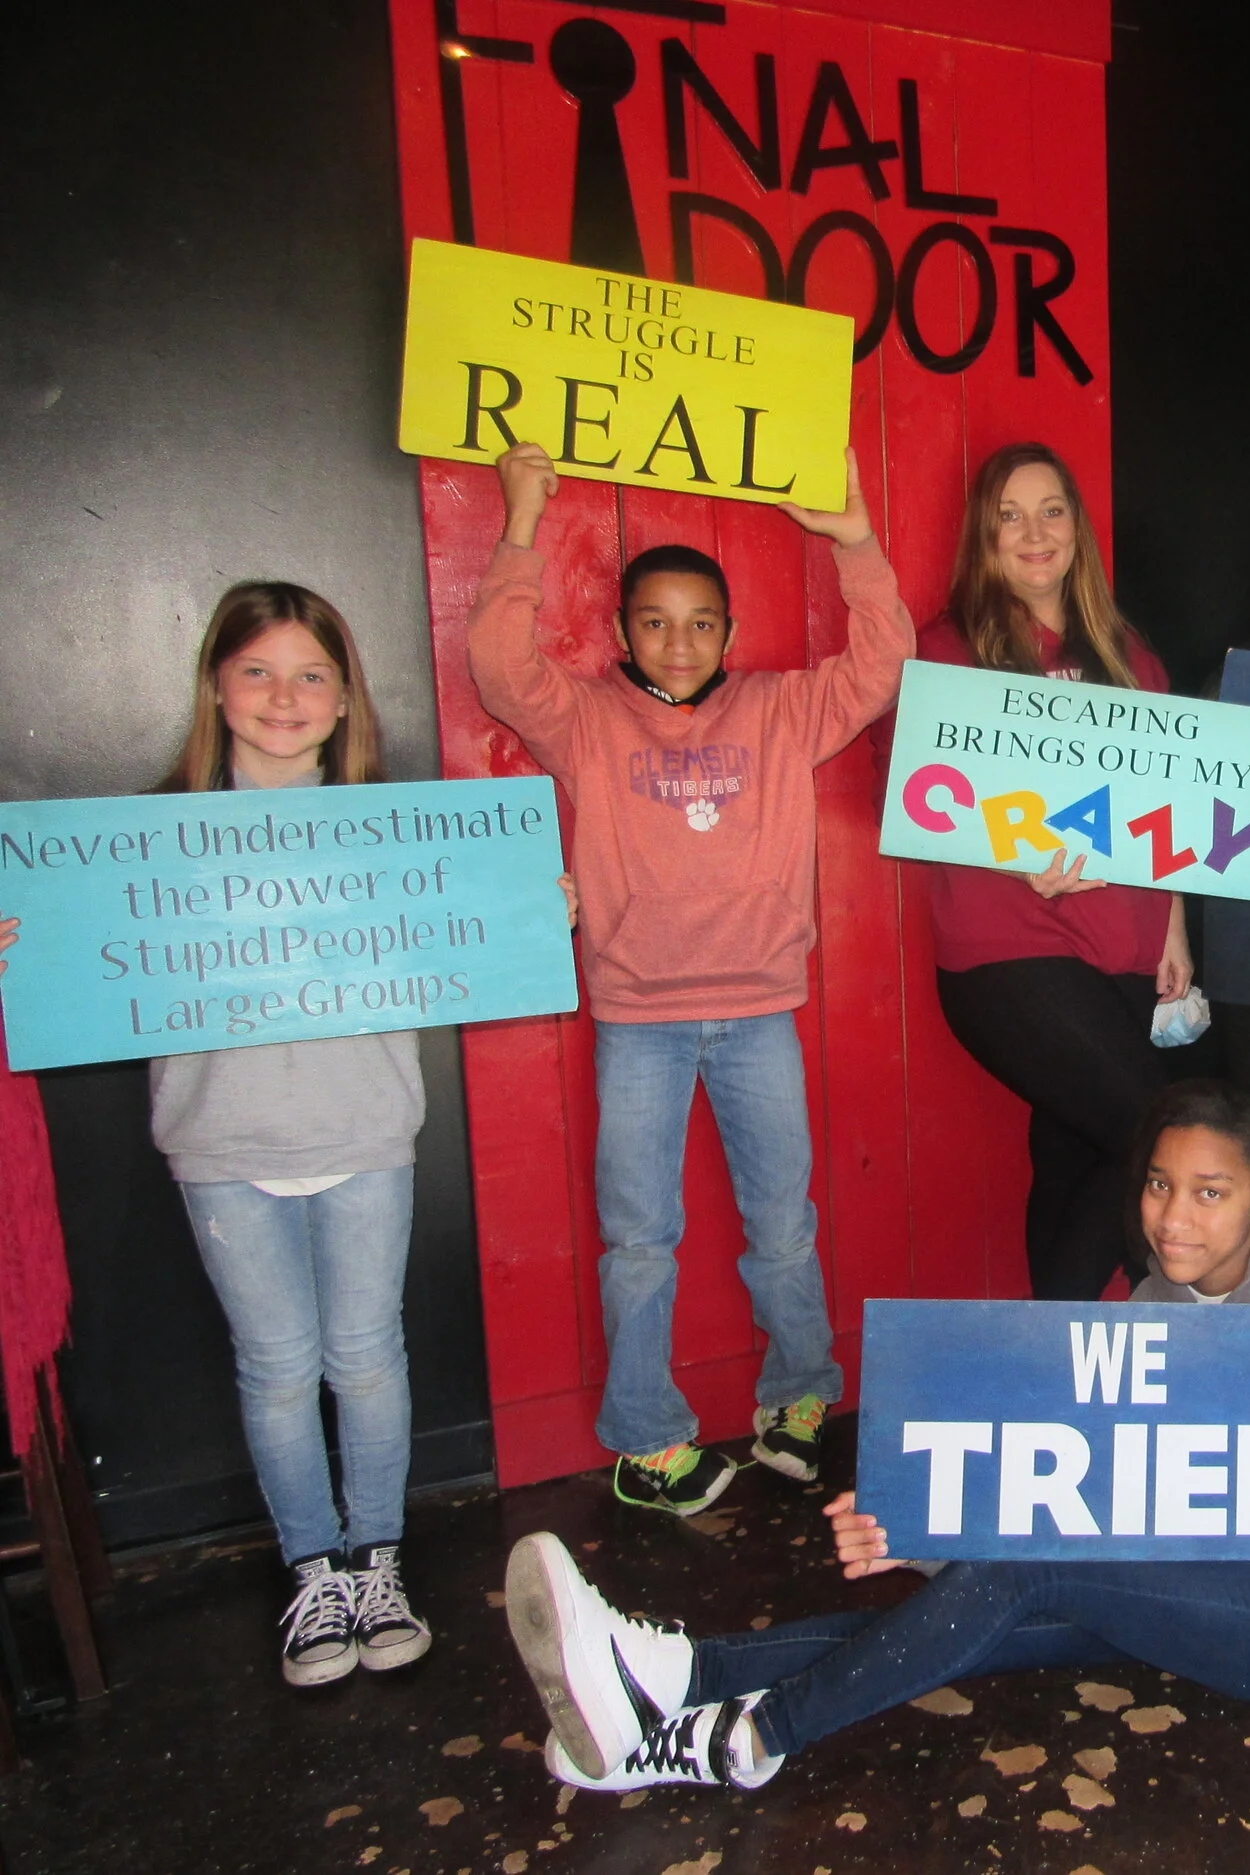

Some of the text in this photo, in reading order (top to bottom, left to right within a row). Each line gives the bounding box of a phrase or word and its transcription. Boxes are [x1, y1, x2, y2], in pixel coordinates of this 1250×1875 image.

[596, 277, 682, 320] THE
[511, 297, 756, 366] STRUGGLE
[616, 349, 655, 382] IS
[453, 361, 797, 494] REAL
[1000, 687, 1201, 741] ESCAPING
[934, 722, 1086, 769] BRINGS
[1098, 746, 1180, 780] OUT
[657, 777, 739, 797] TIGERS
[0, 802, 544, 871] Never Underestimate
[123, 856, 453, 920] the Power of
[101, 911, 486, 982] Stupid People in
[130, 971, 470, 1036] Large Groups
[1069, 1321, 1168, 1404] WE
